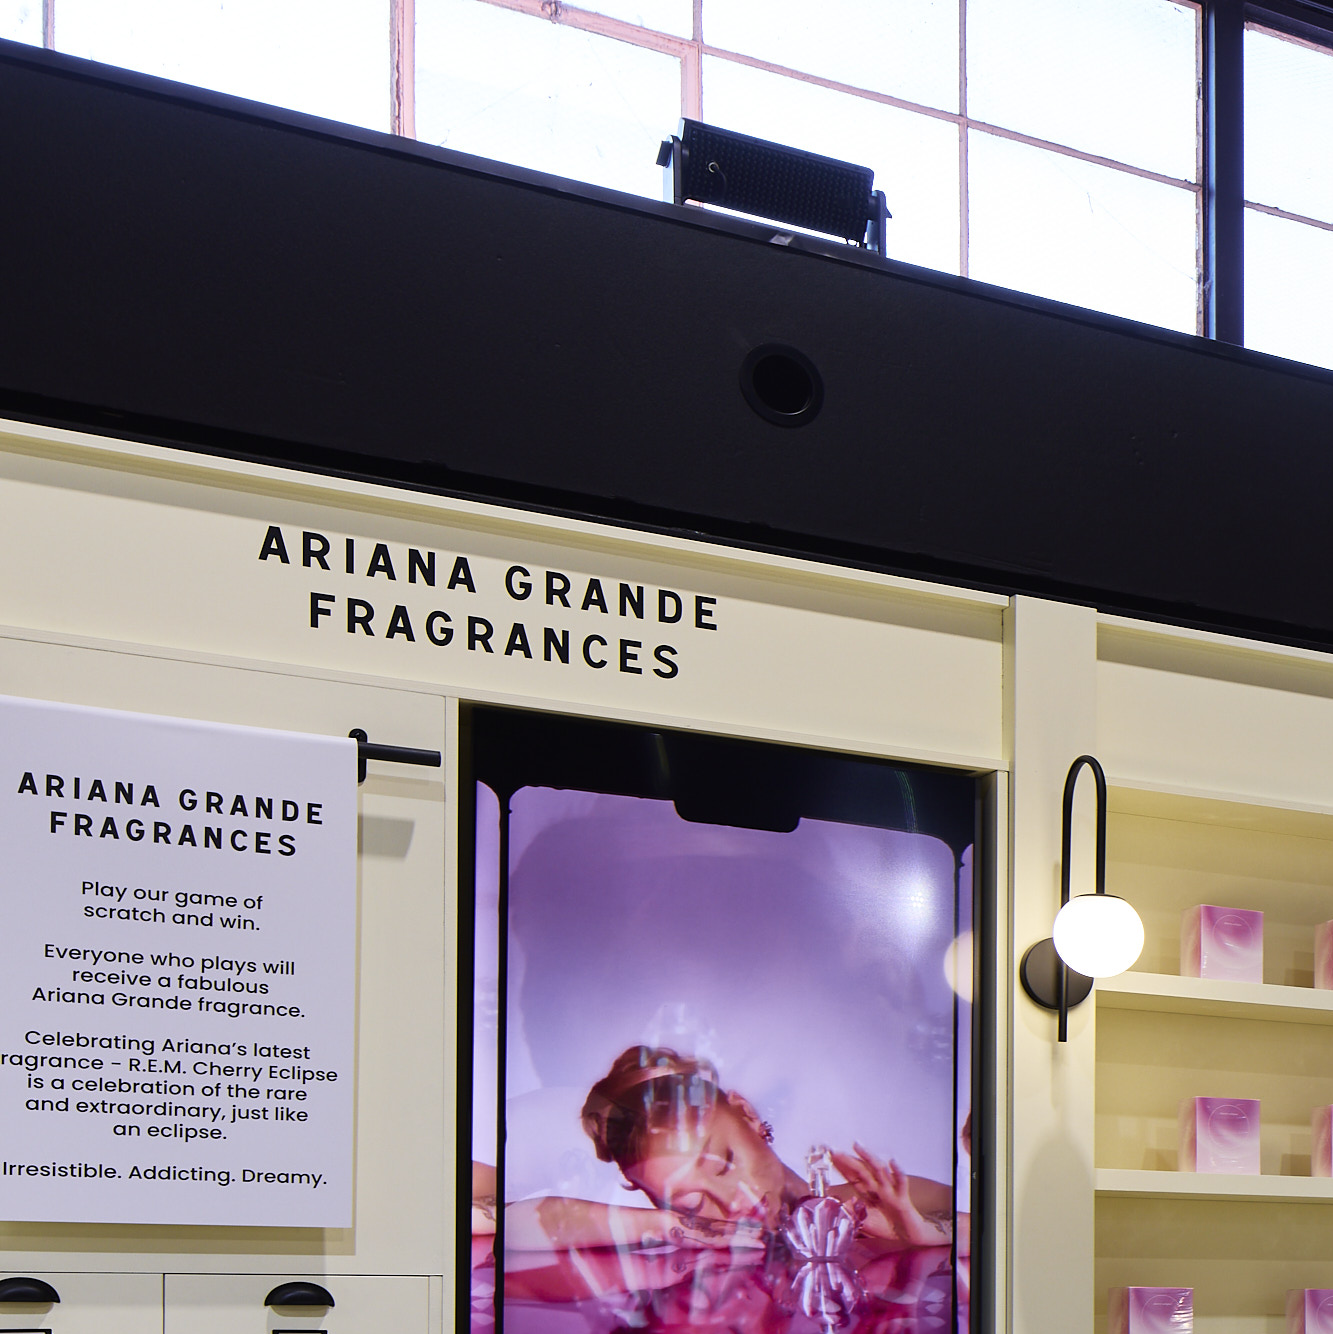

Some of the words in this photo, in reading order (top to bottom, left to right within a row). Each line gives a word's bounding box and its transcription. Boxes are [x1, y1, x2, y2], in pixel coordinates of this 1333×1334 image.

[258, 525, 477, 594] ARIANA
[505, 565, 718, 631] GRANDE
[310, 592, 681, 679] FRAGRANCES
[17, 771, 161, 808] ARIANA
[178, 788, 323, 825] GRANDE
[50, 810, 296, 857] FRAGRANCES
[82, 881, 128, 903] Play
[133, 888, 169, 902] our
[174, 891, 238, 908] game
[243, 895, 264, 910] of
[83, 905, 166, 923] scratch
[172, 912, 214, 927] and
[219, 914, 260, 931] win.
[44, 943, 145, 966] Everyone
[150, 952, 195, 968] who
[201, 955, 257, 976] plays
[262, 960, 295, 976] will
[72, 969, 152, 987] receive
[157, 976, 171, 988] a
[177, 973, 269, 995] fabulous
[31, 987, 105, 1005] Ariana
[111, 992, 192, 1011] Grande
[197, 996, 305, 1018] fragrance.
[24, 1030, 155, 1056] Celebrating
[161, 1038, 247, 1057] Ariana’s
[253, 1042, 311, 1060] latest
[0, 1053, 104, 1071] ragrance
[129, 1057, 187, 1075] R.E.M.
[192, 1061, 263, 1083] Cherry
[269, 1065, 338, 1085] Eclipse
[27, 1073, 44, 1089] is
[50, 1078, 65, 1090] a
[71, 1077, 195, 1096] celebration
[201, 1082, 222, 1097] of
[226, 1083, 261, 1099] the
[266, 1088, 308, 1101] rare
[25, 1097, 69, 1112] and
[76, 1099, 226, 1123] extraordinary,
[230, 1104, 269, 1124] just
[275, 1106, 309, 1122] like
[112, 1124, 141, 1137] an
[147, 1123, 227, 1143] eclipse.
[3, 1161, 122, 1179] Irresistible.
[128, 1165, 236, 1187] Addicting.
[242, 1169, 327, 1189] Dreamy.
